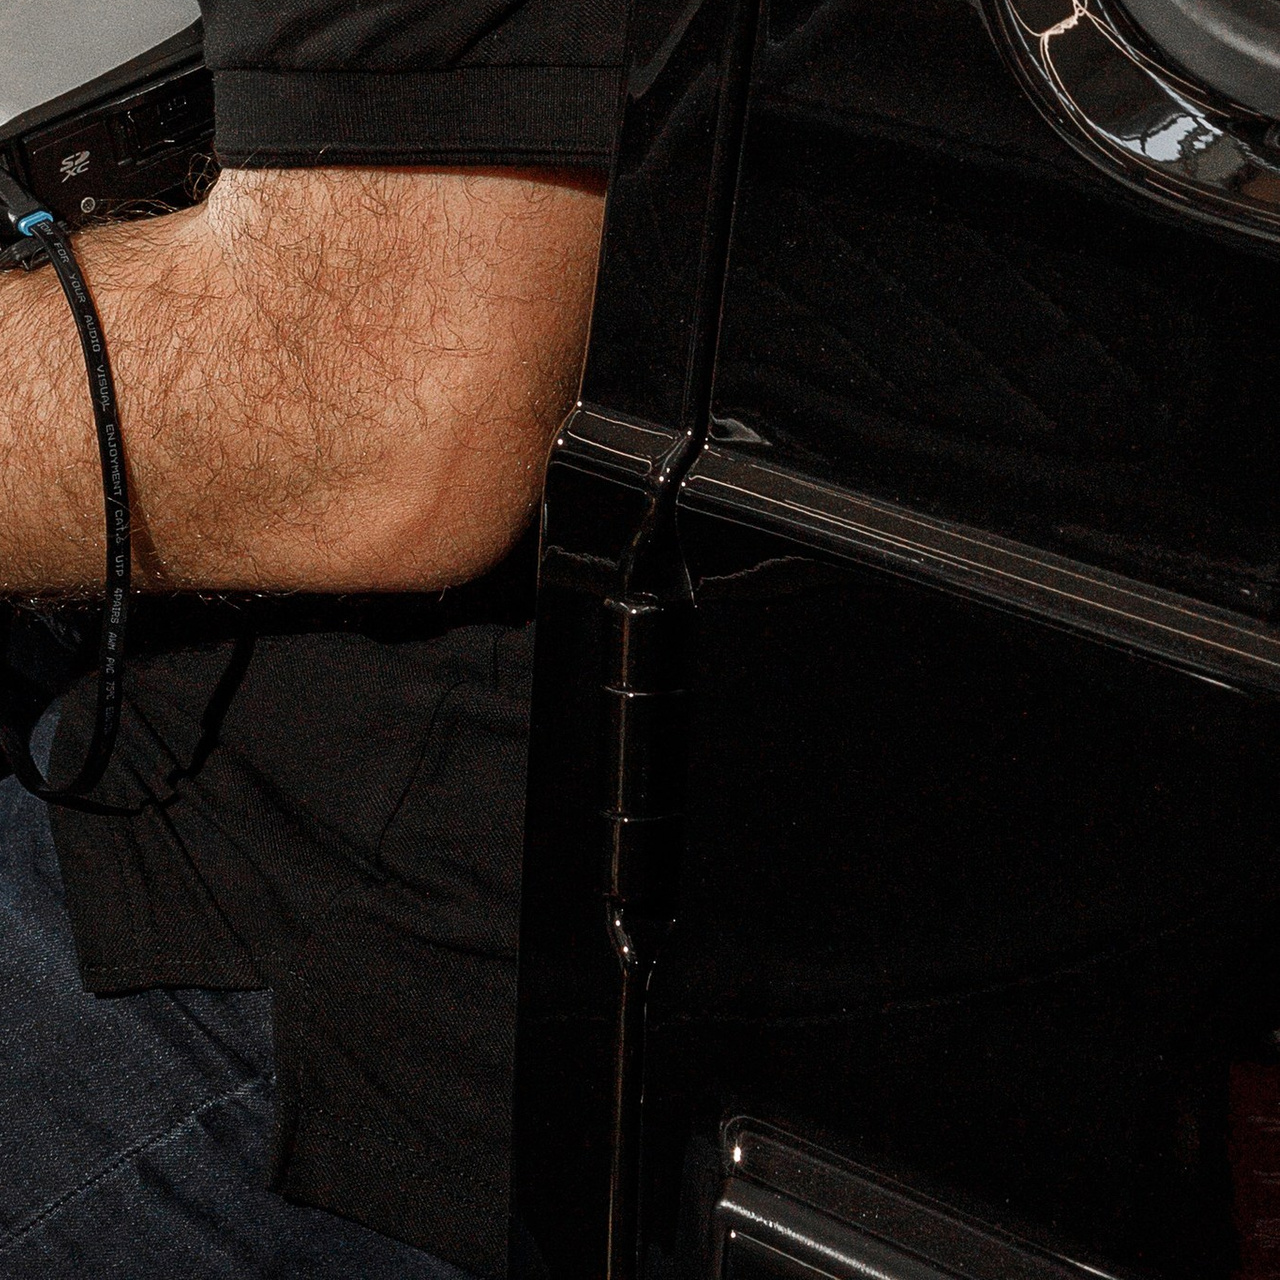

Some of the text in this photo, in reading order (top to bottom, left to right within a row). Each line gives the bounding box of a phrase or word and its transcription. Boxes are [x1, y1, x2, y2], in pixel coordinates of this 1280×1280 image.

[53, 242, 70, 264] FOR
[68, 273, 86, 303] YOUR
[84, 314, 101, 353] AUDIO
[96, 364, 110, 411] VISUAL
[105, 423, 123, 497] ENJOYMENT
[115, 554, 125, 577] UTP
